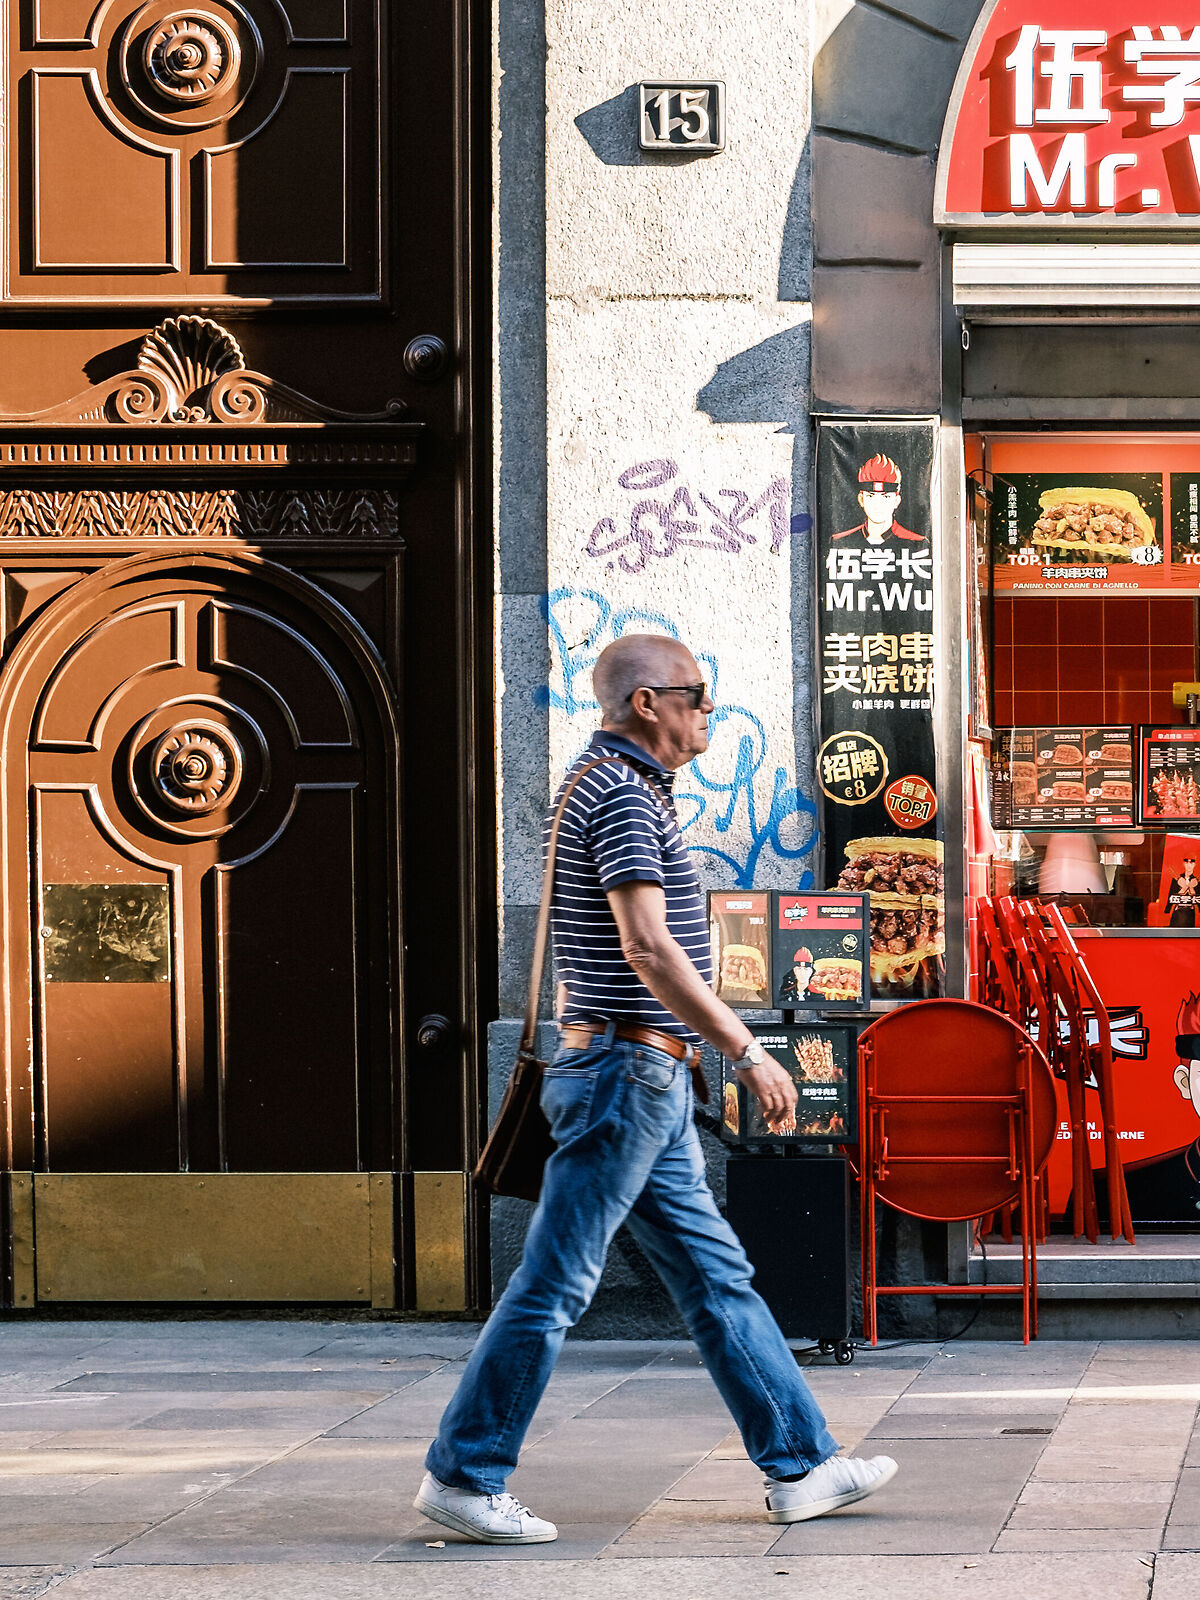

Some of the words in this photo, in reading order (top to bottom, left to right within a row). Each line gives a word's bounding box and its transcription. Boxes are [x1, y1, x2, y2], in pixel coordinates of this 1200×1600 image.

[653, 90, 709, 141] 15
[1008, 132, 1162, 209] Mr.
[825, 548, 933, 581] 伍学长
[1008, 553, 1051, 566] TOP.1
[1042, 566, 1108, 579] 羊肉串夹饼
[825, 582, 933, 612] Mr.Wu
[823, 631, 934, 663] 羊肉串
[823, 664, 933, 695] 夹烧饼
[823, 748, 880, 784] 招牌
[844, 779, 867, 798] €8
[889, 793, 931, 820] TOP.1
